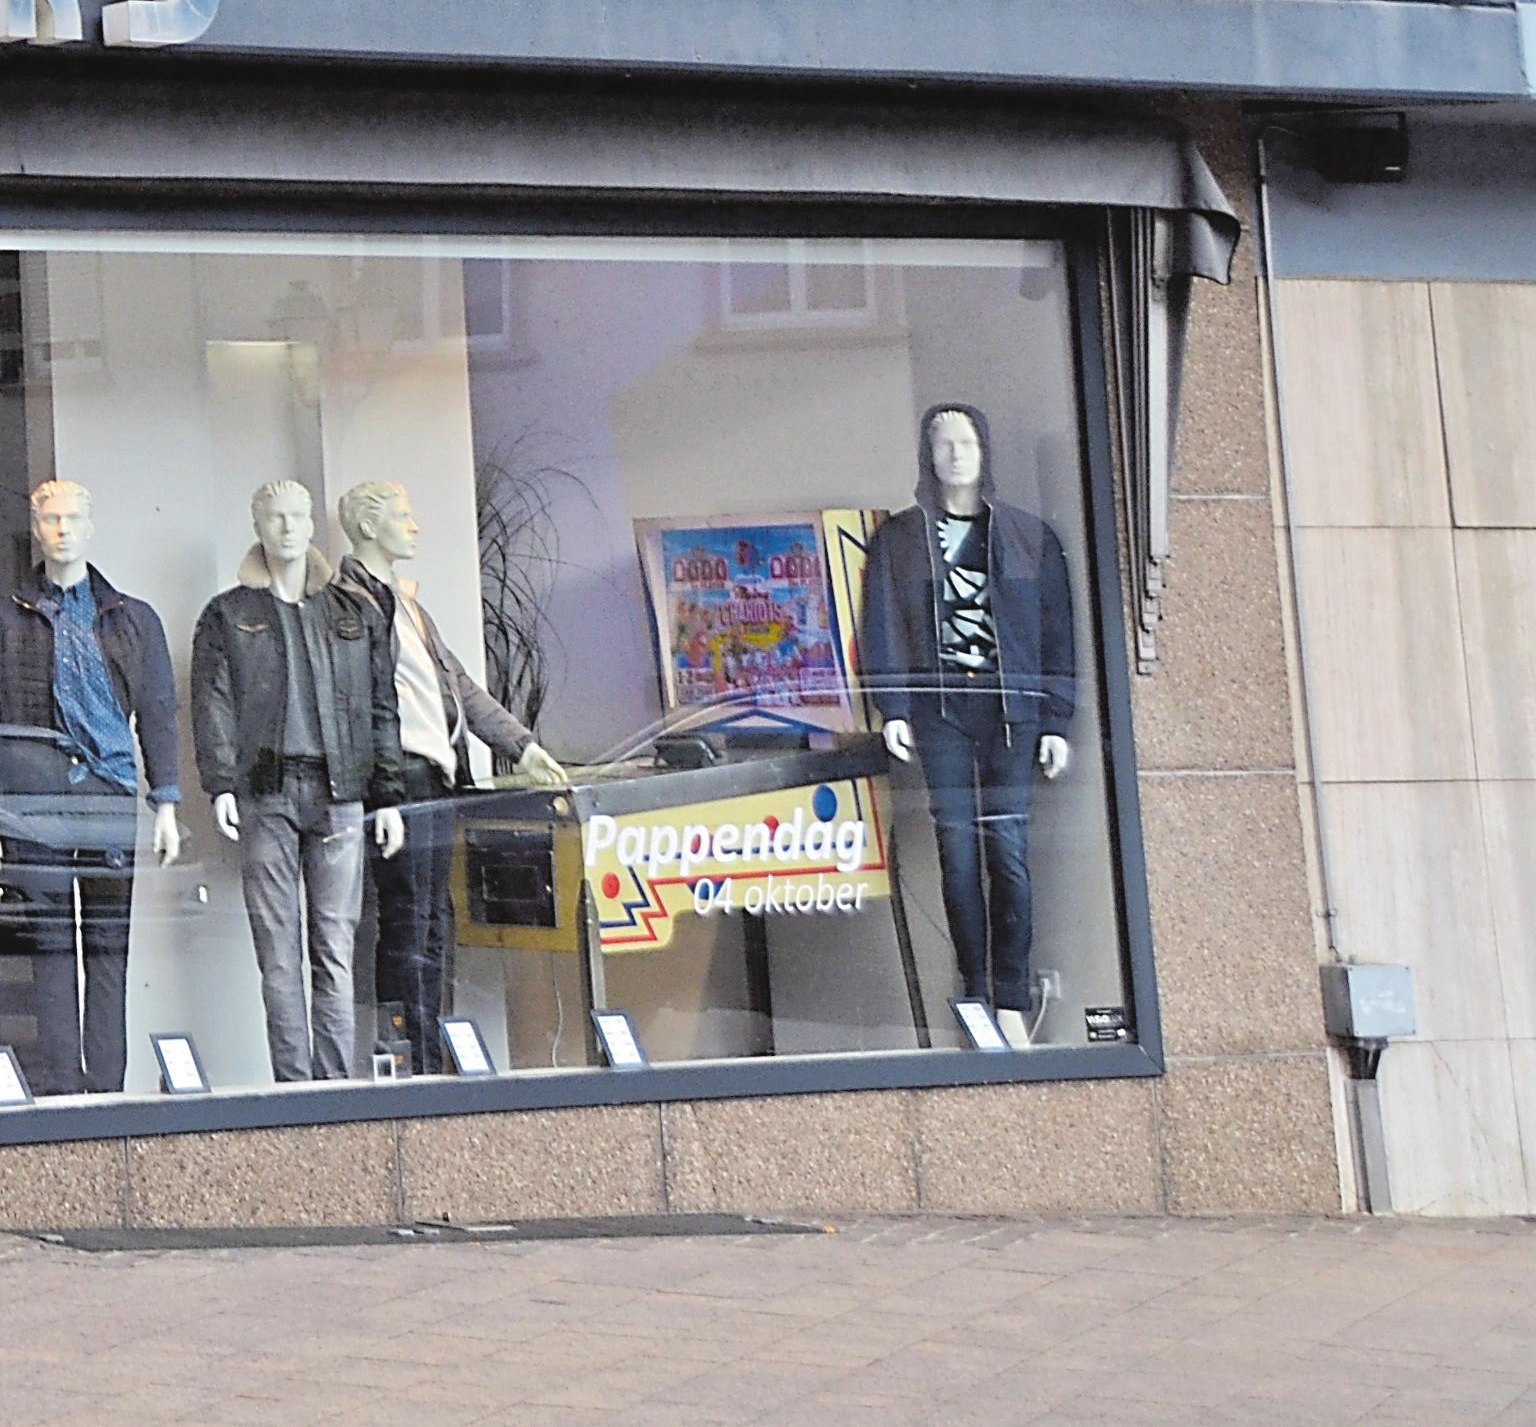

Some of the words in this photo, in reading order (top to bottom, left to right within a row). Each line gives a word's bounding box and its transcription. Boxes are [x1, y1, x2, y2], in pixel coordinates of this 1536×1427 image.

[585, 807, 866, 872] Pappendag
[693, 877, 733, 916] 04
[745, 875, 868, 916] oktober
